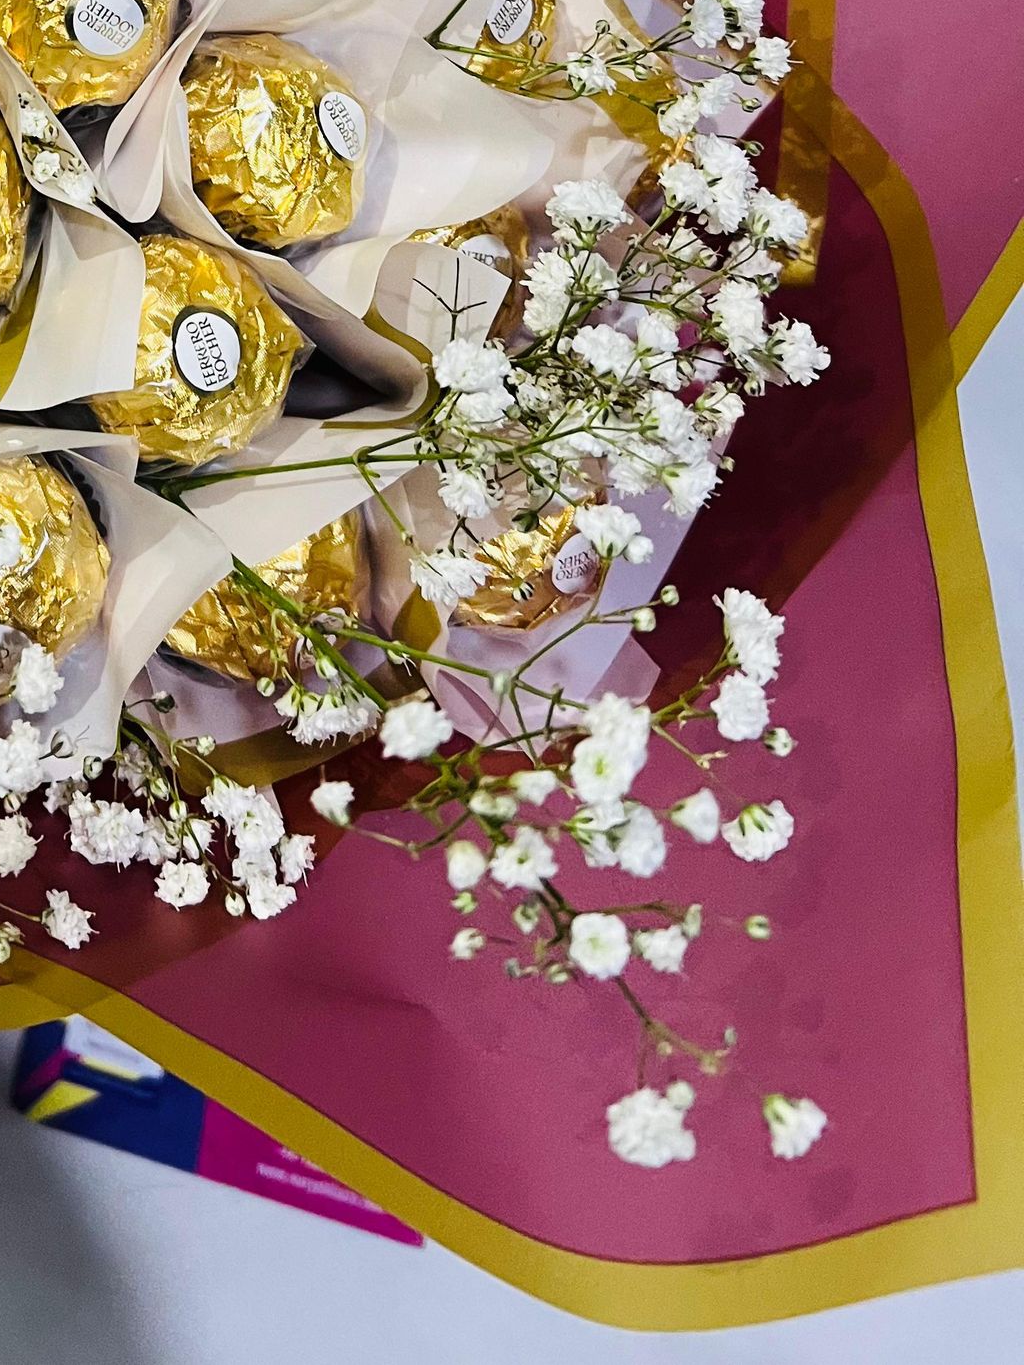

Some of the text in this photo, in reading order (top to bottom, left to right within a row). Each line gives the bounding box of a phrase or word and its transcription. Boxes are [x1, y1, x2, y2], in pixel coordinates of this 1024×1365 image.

[77, 9, 130, 49] FERRERO
[323, 99, 356, 158] FERRERO
[185, 321, 218, 387] FERRERO
[198, 317, 229, 383] ROCHER
